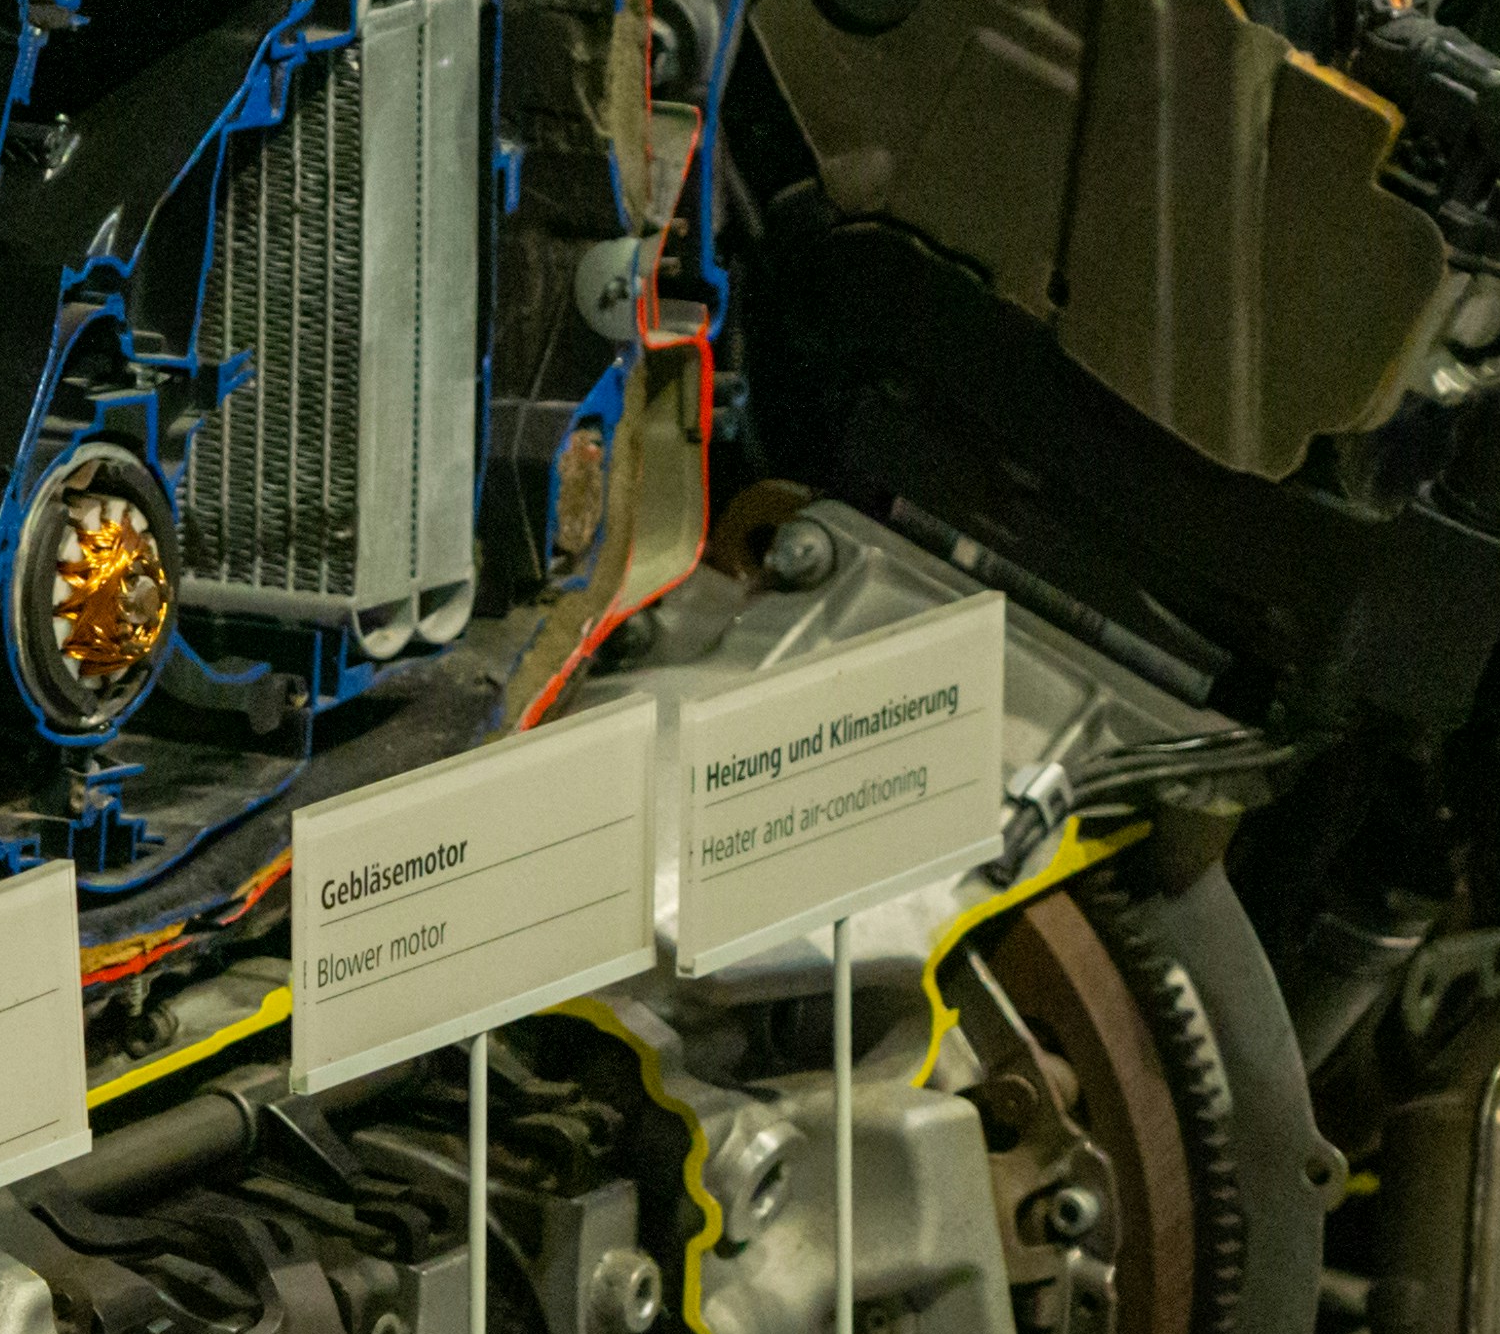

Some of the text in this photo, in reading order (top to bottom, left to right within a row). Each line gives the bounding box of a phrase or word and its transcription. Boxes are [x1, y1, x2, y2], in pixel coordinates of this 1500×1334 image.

[706, 682, 960, 793] Heizung und Klimatisierung
[701, 764, 928, 867] Heater and air-conditioning
[320, 838, 468, 912] Gebläsemotor
[316, 917, 448, 989] Blower motor
